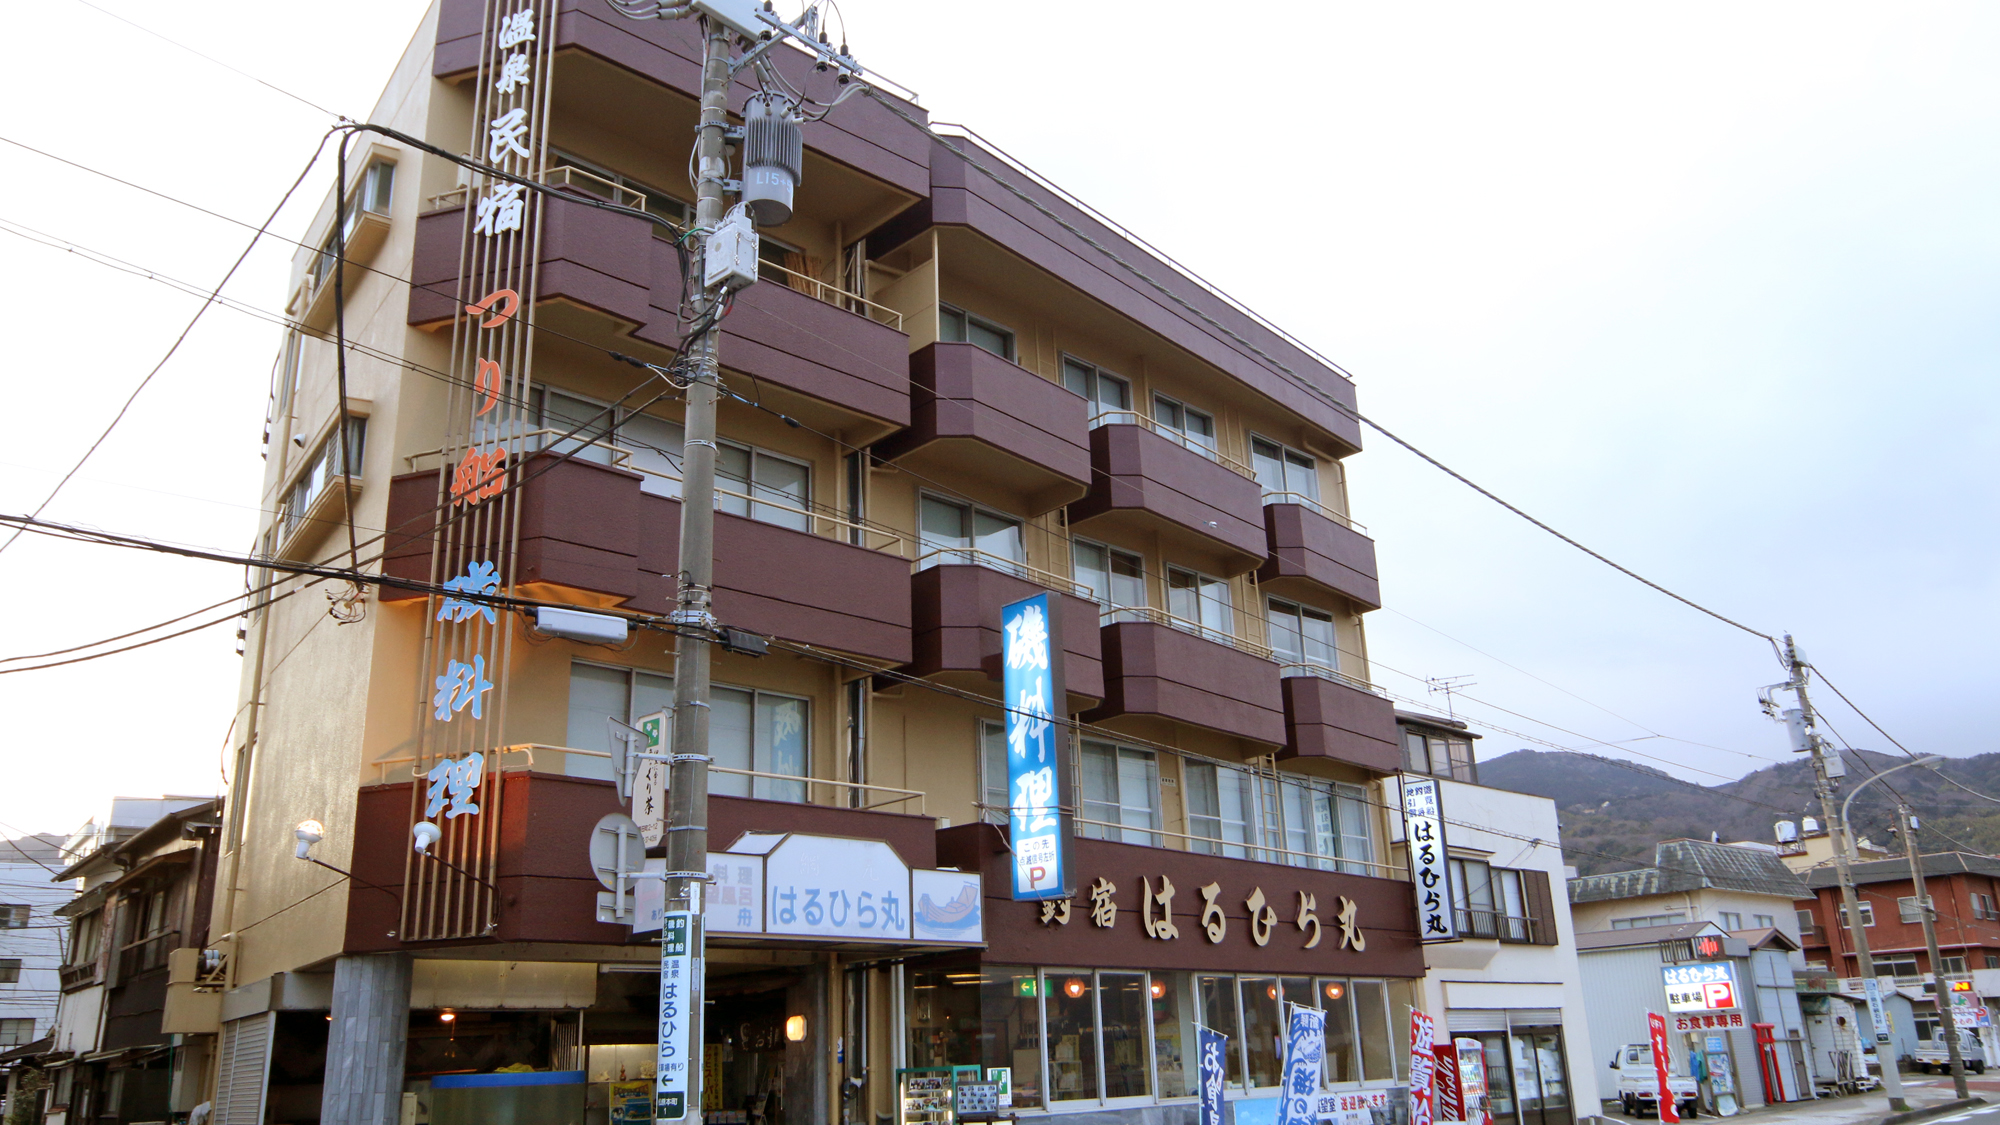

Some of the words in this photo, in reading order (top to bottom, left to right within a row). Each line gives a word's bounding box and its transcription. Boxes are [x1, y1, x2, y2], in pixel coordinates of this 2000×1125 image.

[473, 9, 536, 237] 温泉民宿
[450, 288, 518, 506] つり船
[425, 560, 501, 819] 磯料理
[1005, 604, 1057, 833] 磯料理
[1024, 838, 1049, 852] この先
[1030, 866, 1046, 889] P
[1414, 820, 1448, 935] はるひら丸
[772, 885, 906, 931] はるひら丸
[1664, 964, 1729, 985] はるひら丸
[1669, 991, 1703, 1004] 駐車場
[1705, 984, 1730, 1008] P
[661, 982, 678, 1058] はるひら
[1675, 1014, 1743, 1030] お食事専用
[1317, 1097, 1336, 1113] 望室
